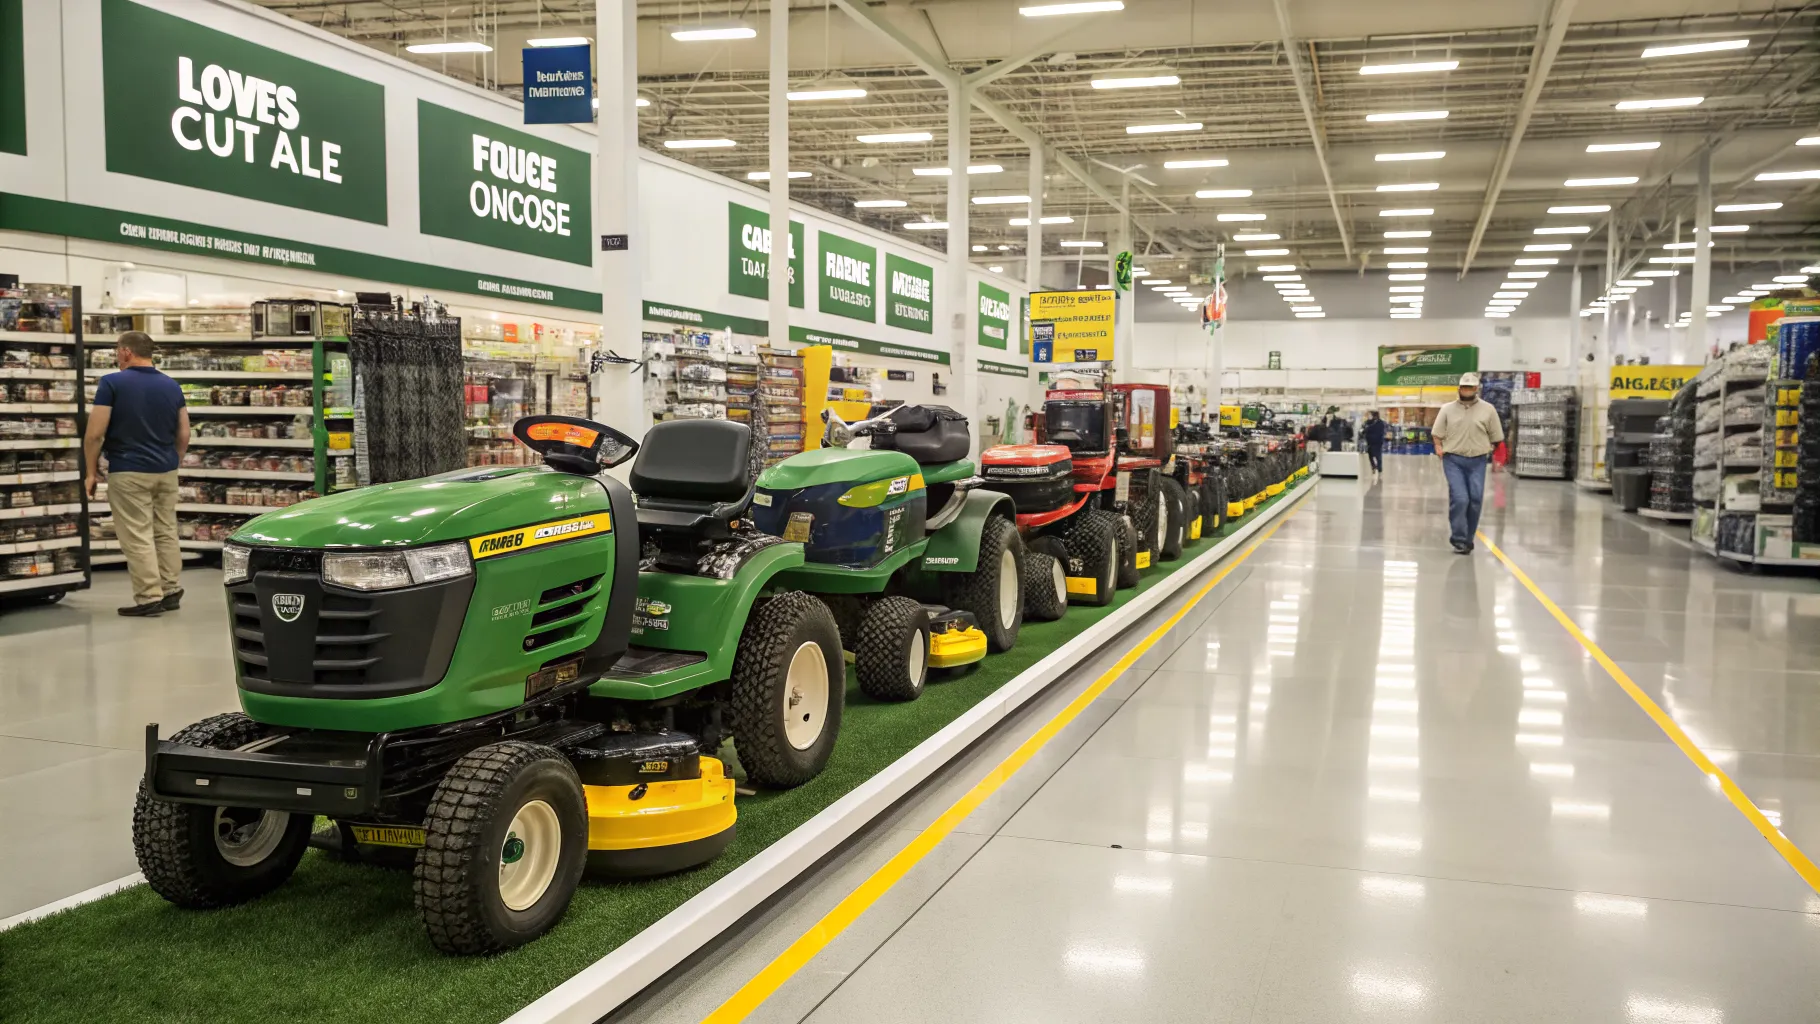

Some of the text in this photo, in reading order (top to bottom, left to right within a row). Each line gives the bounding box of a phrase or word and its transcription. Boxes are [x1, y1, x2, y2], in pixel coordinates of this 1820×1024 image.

[178, 56, 300, 130] LOVES
[171, 106, 342, 184] CUT ALE
